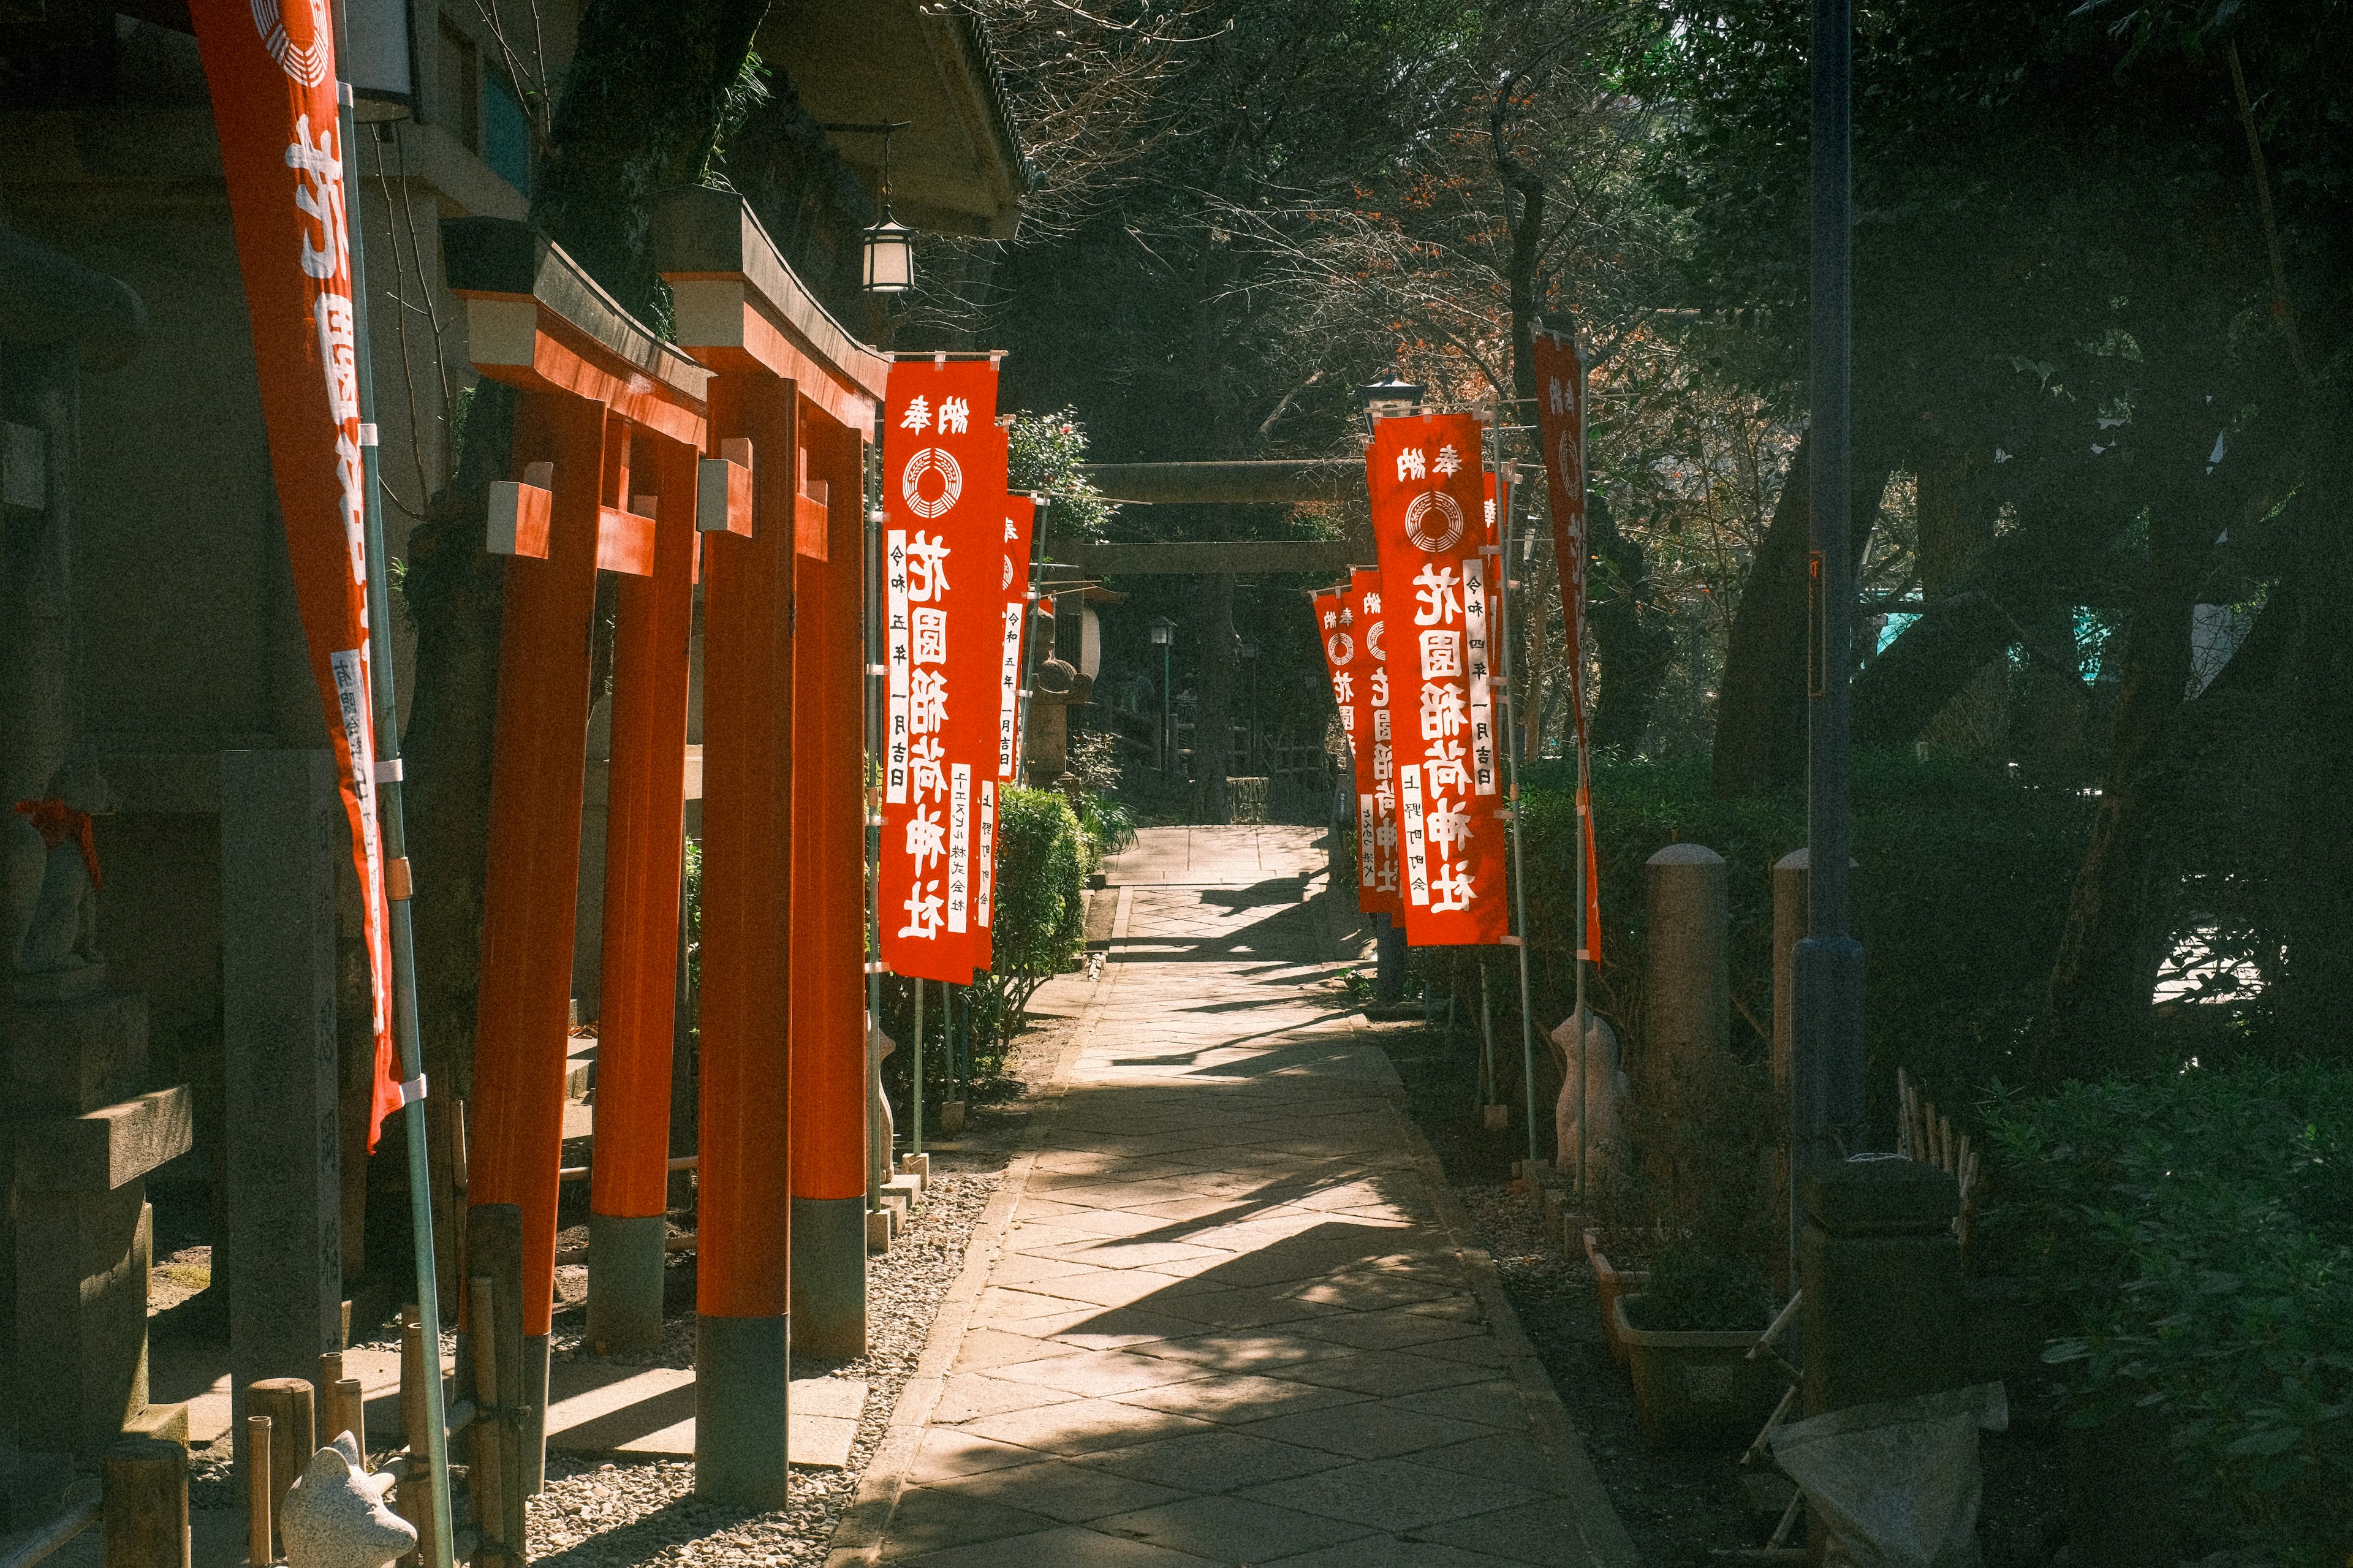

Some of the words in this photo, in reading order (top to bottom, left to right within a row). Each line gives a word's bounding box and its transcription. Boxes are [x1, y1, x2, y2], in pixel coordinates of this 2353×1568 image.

[1000, 612, 1020, 765] 令和五年一月吉日
